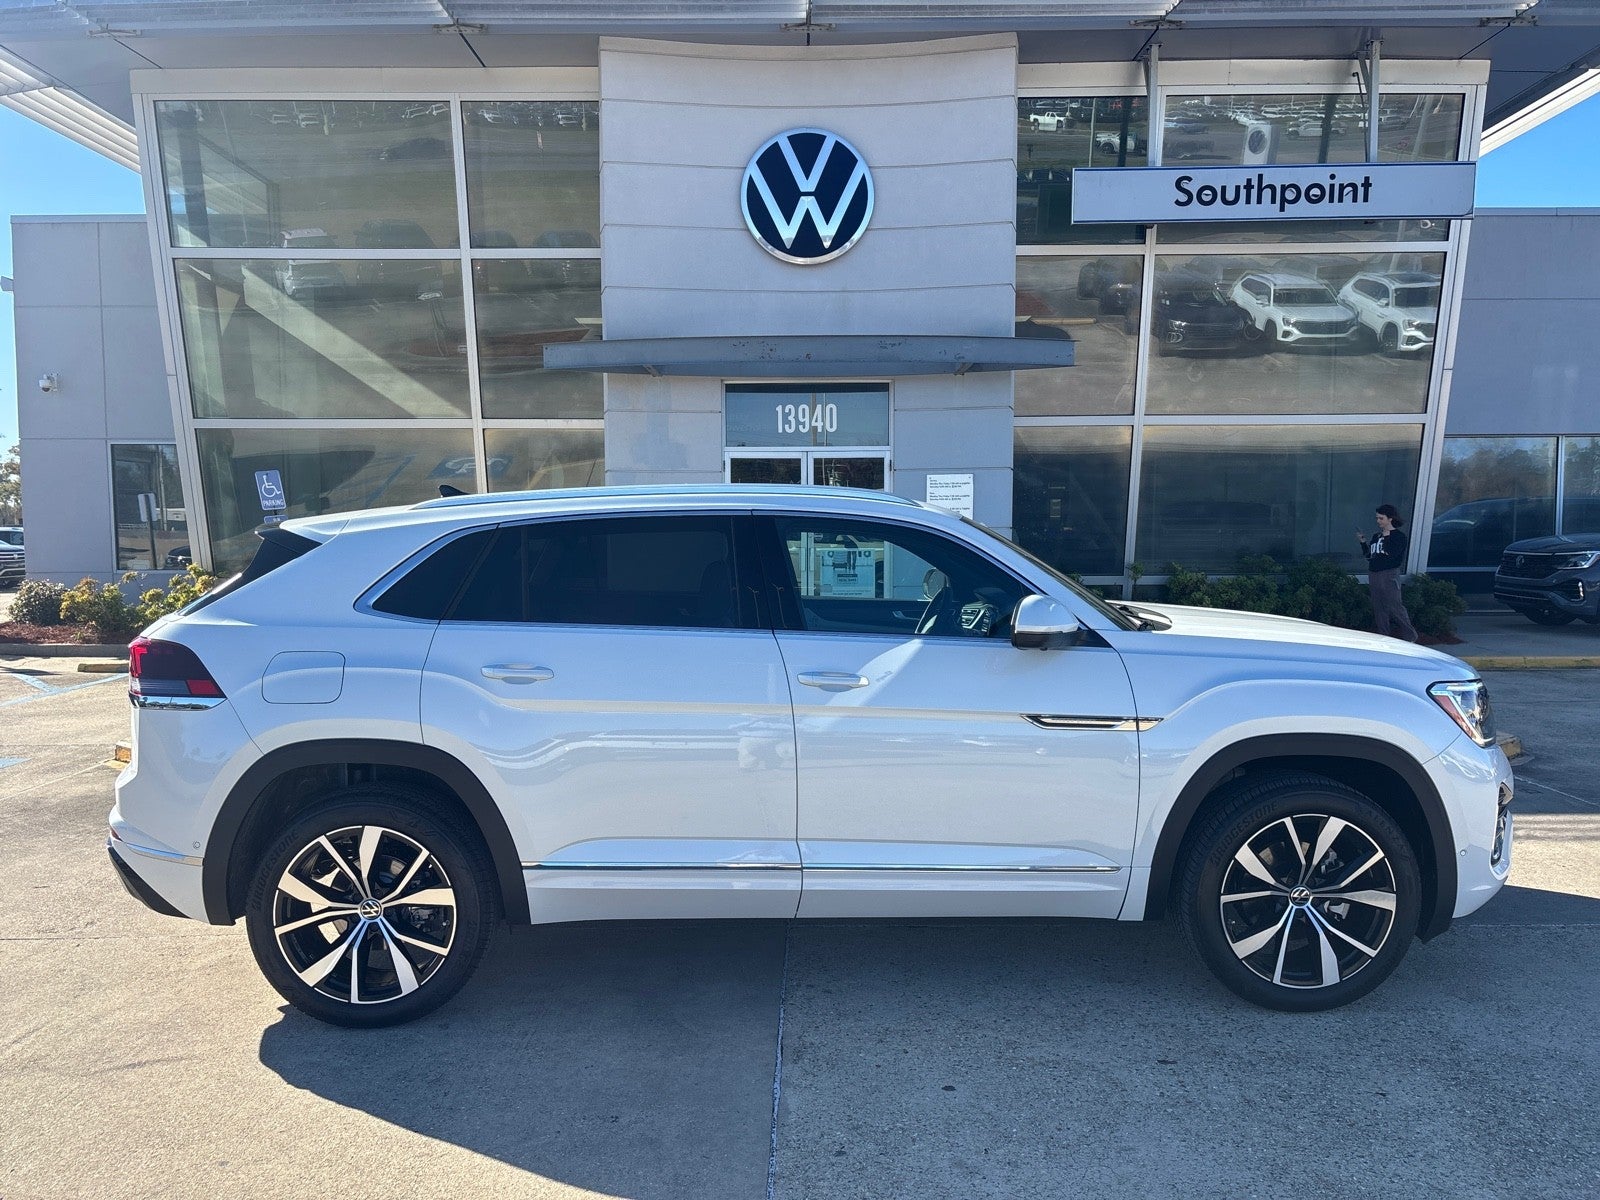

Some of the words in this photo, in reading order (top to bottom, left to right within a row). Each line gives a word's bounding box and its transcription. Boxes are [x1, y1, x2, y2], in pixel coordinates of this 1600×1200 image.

[741, 127, 875, 265] VW
[1174, 173, 1373, 212] Southpoint
[775, 403, 838, 434] 13940
[263, 499, 284, 507] PARKING
